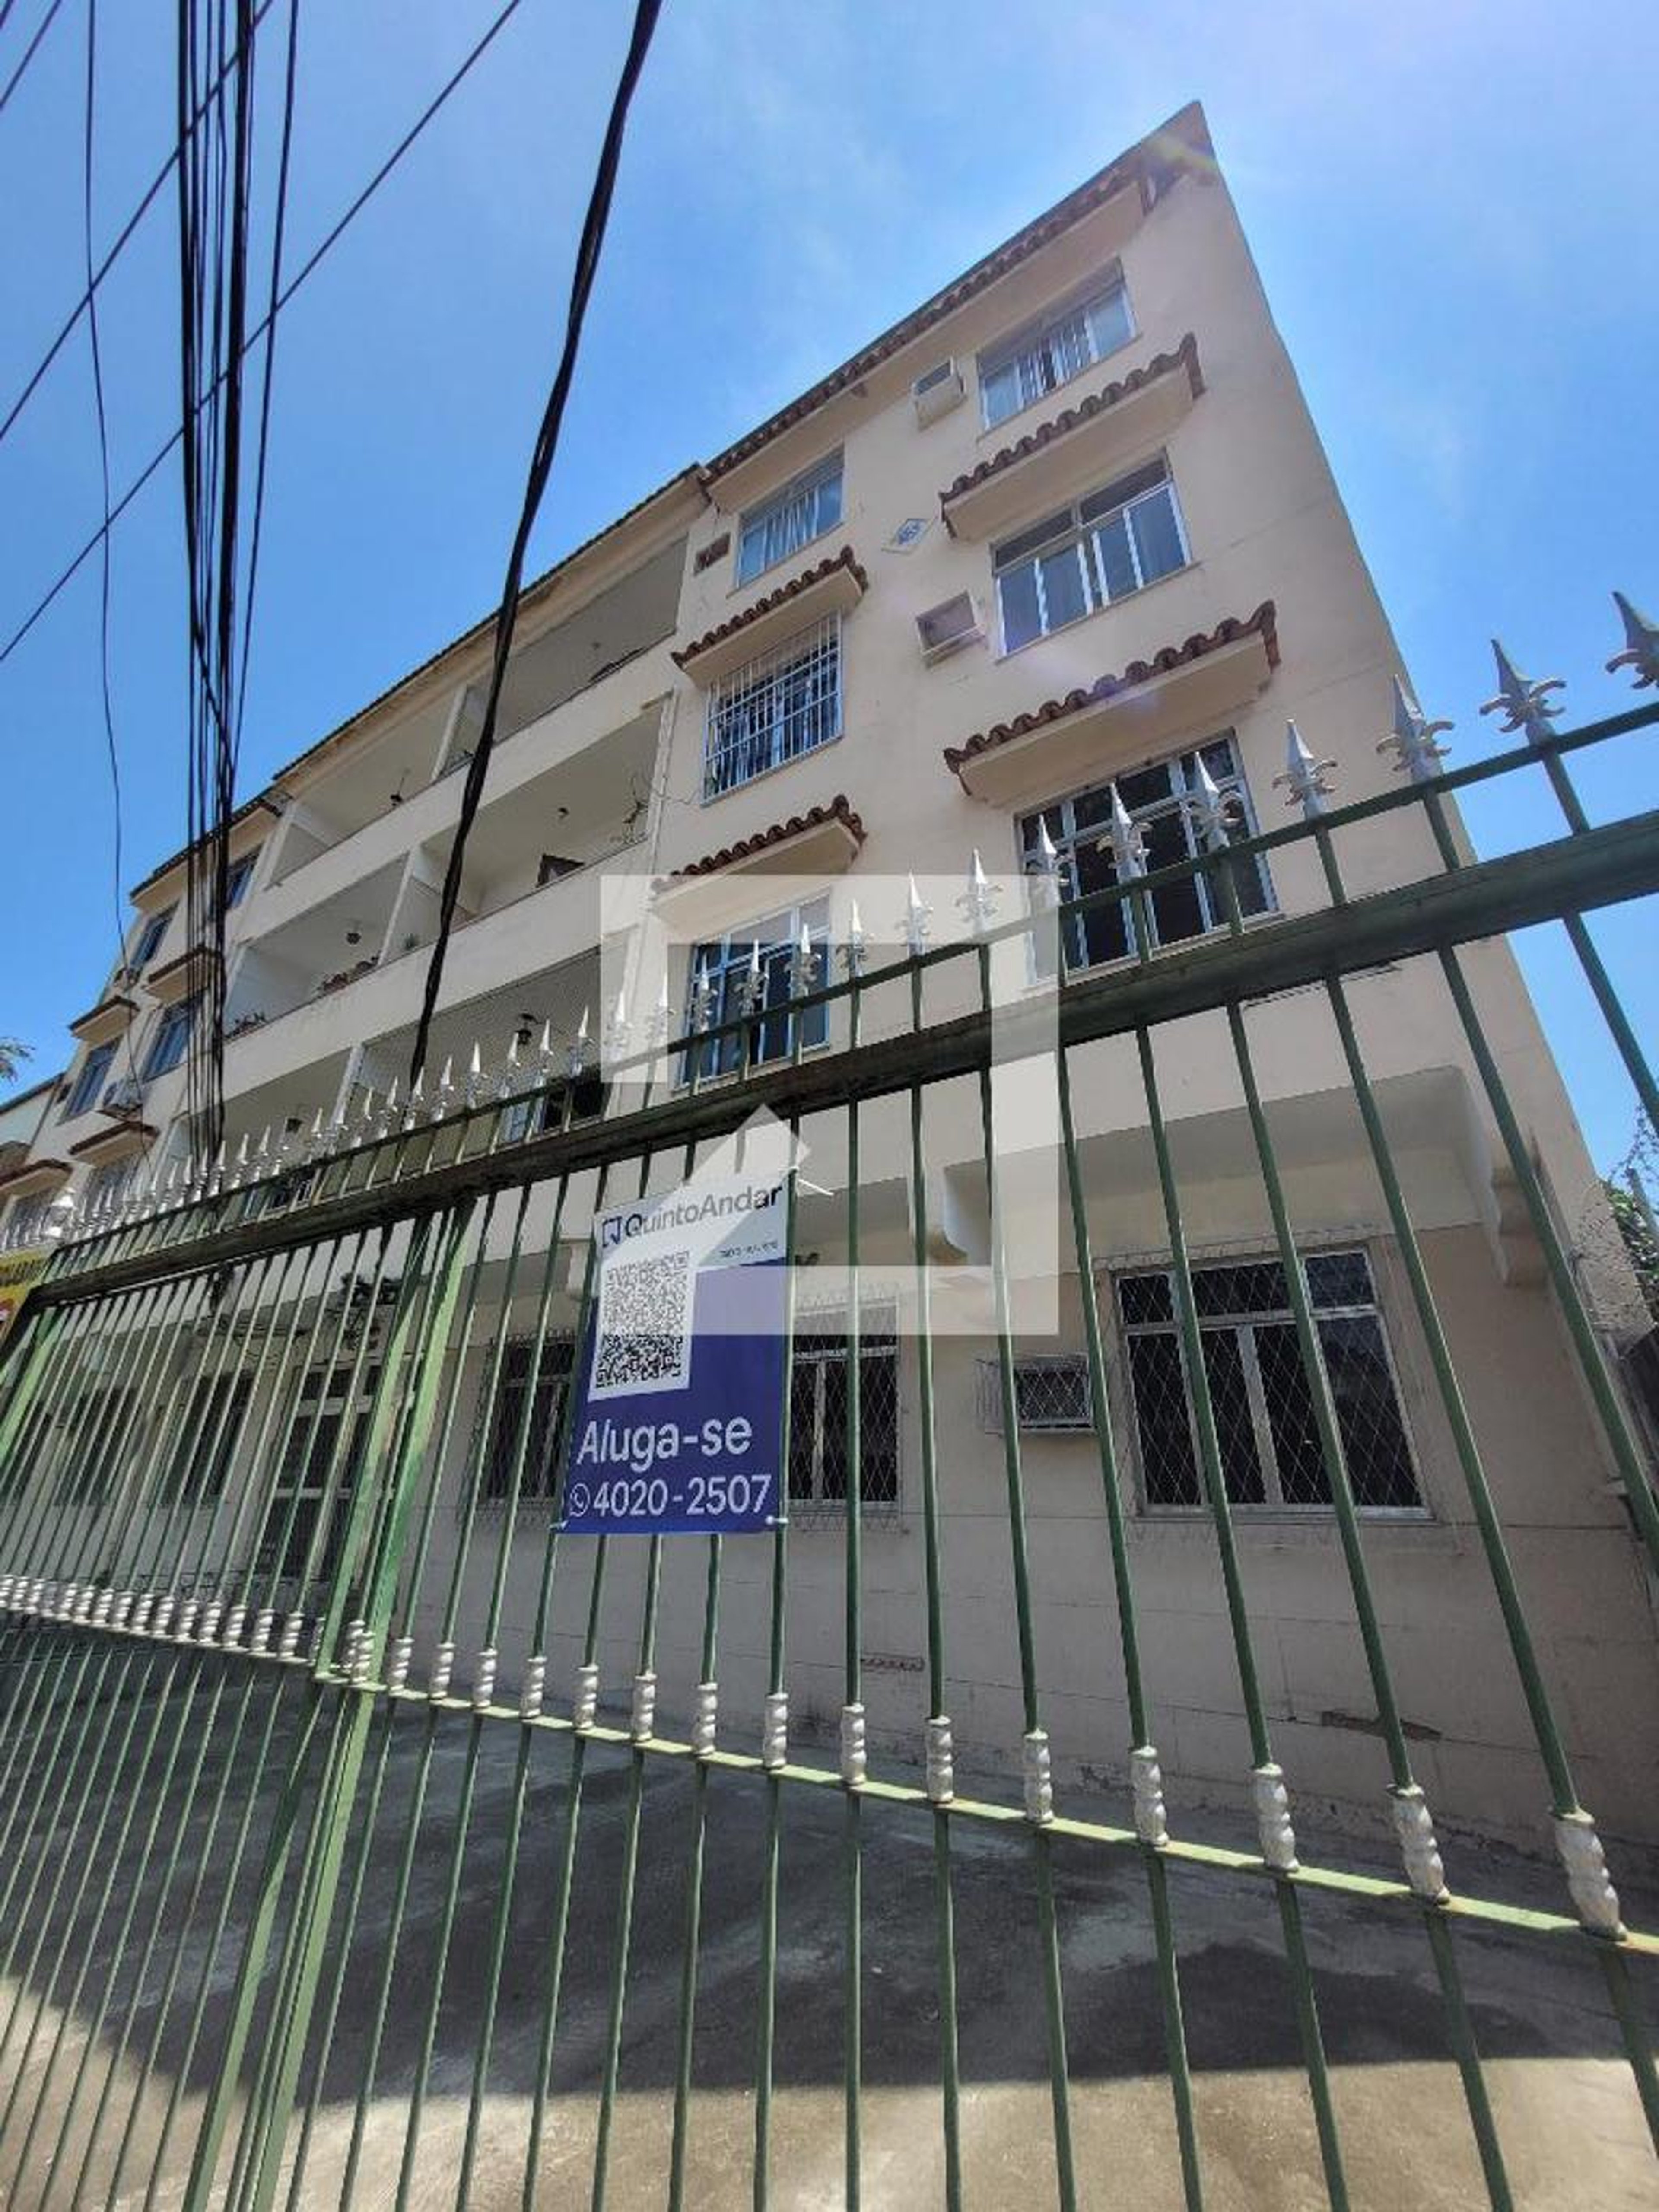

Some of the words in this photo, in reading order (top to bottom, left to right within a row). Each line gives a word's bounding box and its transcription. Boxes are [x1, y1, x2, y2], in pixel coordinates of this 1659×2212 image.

[625, 1186, 782, 1237] QuintoAndar
[576, 1416, 753, 1473] Aluga-se
[593, 1474, 772, 1517] 4020-2507
